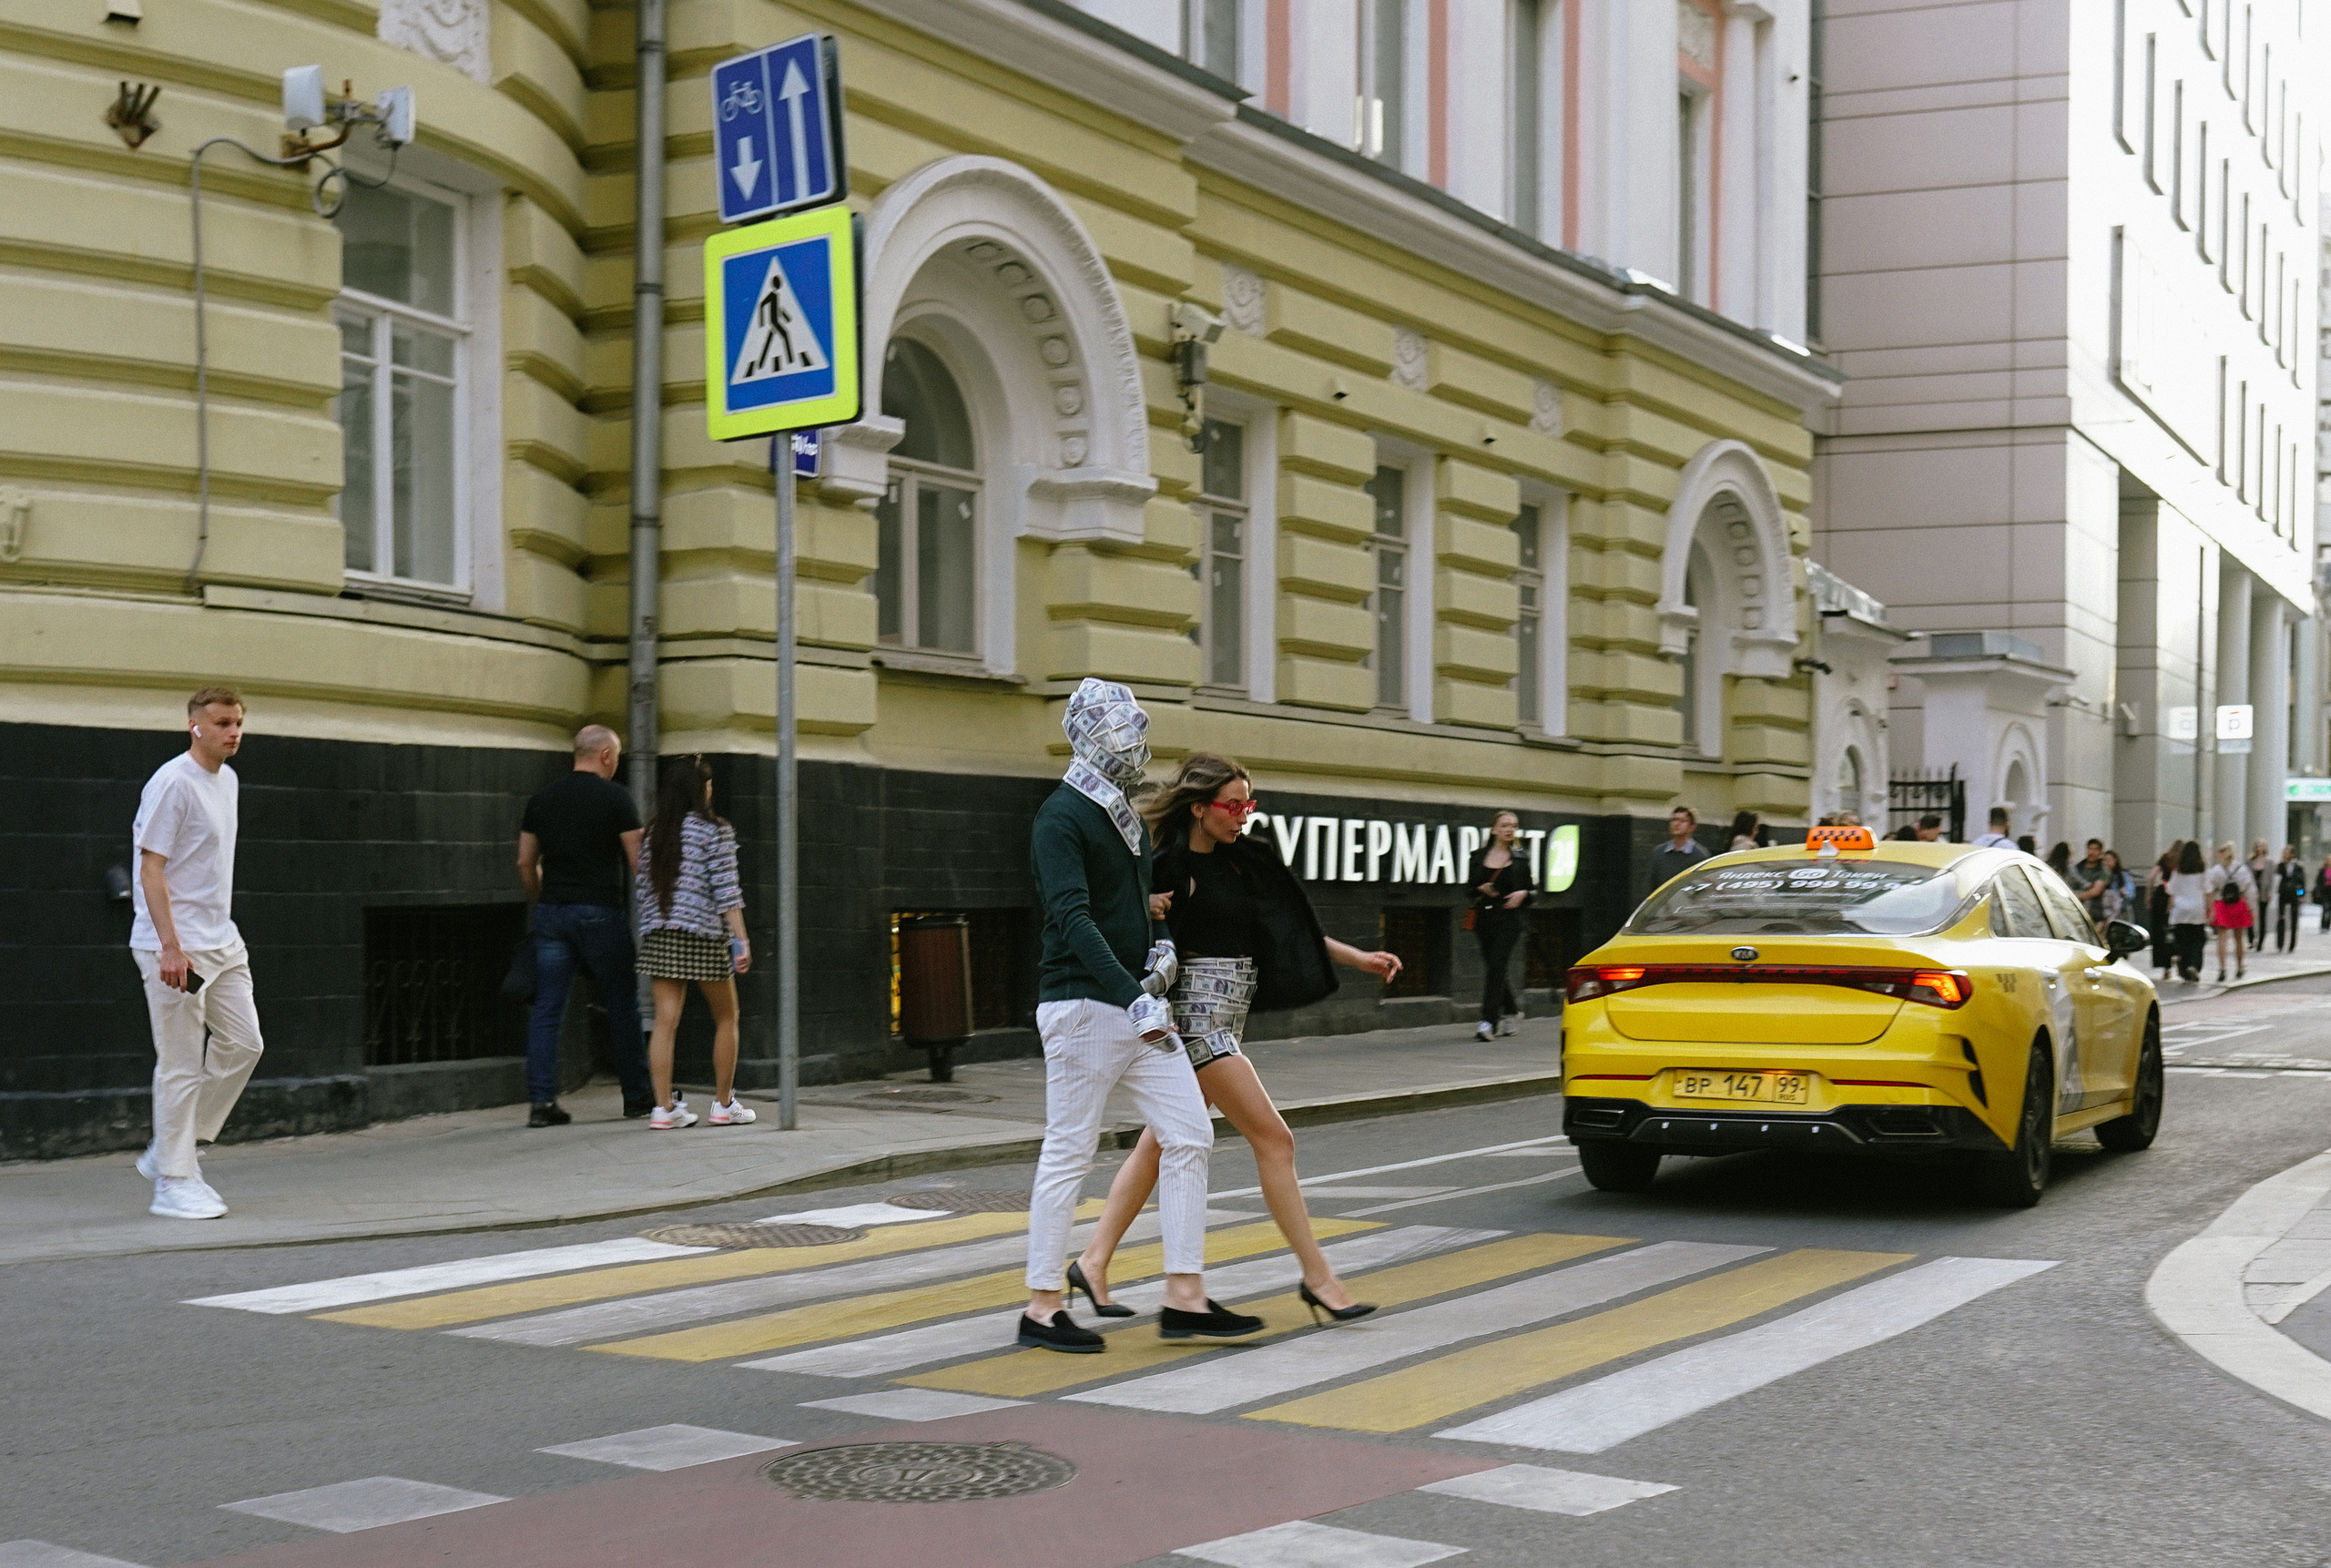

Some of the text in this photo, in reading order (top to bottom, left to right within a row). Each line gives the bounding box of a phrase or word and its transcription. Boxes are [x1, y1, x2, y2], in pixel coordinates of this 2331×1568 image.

[1241, 811, 1576, 886] УПЕРМАРТ 24
[1681, 882, 1713, 891] +7
[1715, 880, 1785, 891] (495)
[1789, 880, 1839, 889] 999
[1843, 880, 1878, 890] 99
[1723, 1074, 1763, 1097] 147
[1778, 1076, 1800, 1094] 99
